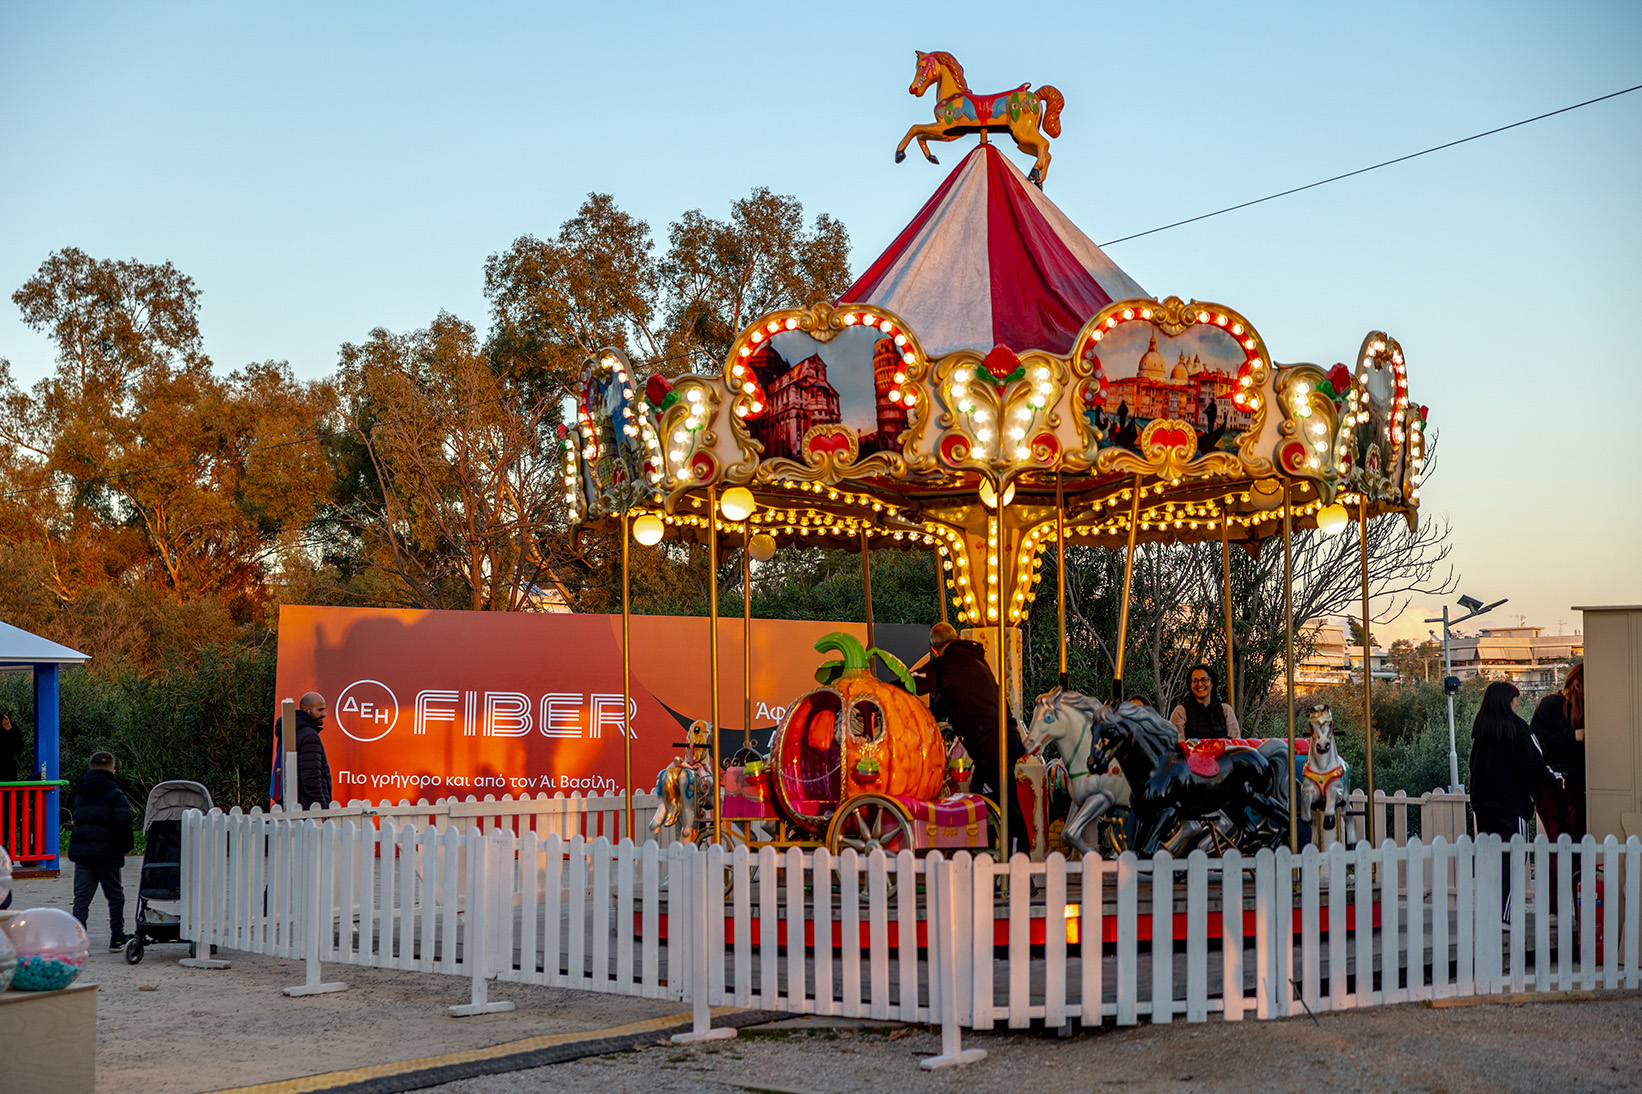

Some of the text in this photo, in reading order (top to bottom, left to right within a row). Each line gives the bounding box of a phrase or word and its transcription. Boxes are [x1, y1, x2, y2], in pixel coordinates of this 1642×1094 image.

[342, 696, 389, 725] ΔΕΗ
[413, 689, 639, 740] FIBER
[338, 770, 621, 792] Πιο γρήγορο και από τον Άι Βασίλη.
